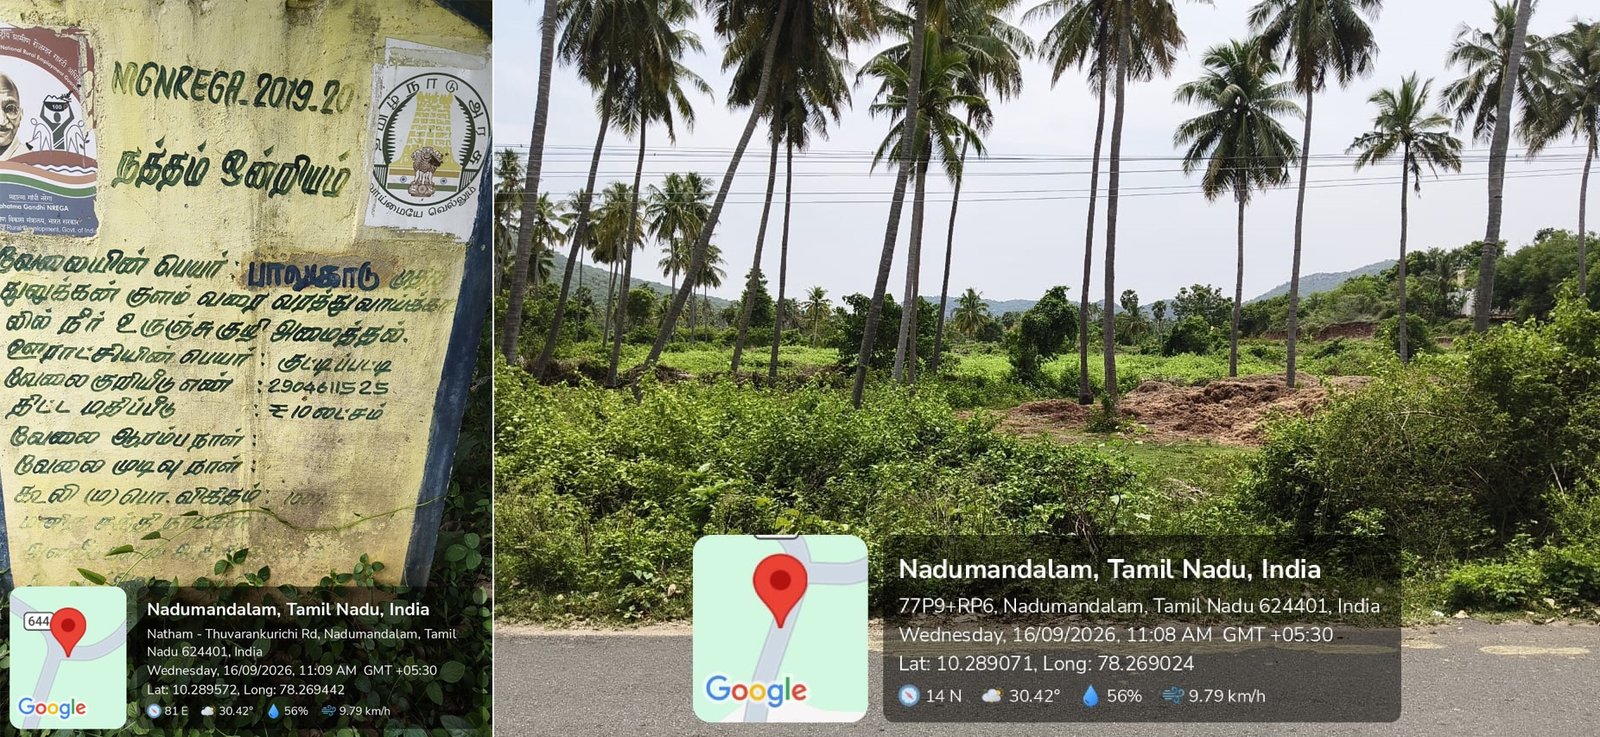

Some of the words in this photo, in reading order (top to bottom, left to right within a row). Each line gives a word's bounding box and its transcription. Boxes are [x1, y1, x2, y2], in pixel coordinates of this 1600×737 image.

[23, 49, 36, 58] Rural
[37, 55, 64, 76] Employment
[110, 134, 210, 192] நத்தம்
[221, 145, 352, 199] ஒன்றியம்
[23, 203, 46, 211] Gandhi
[46, 204, 69, 212] NREGA
[428, 185, 477, 217] வெல்லும்
[153, 250, 229, 279] பெயர்
[0, 276, 121, 307] துலுக்கன்
[126, 284, 192, 307] குளம்
[197, 291, 269, 314] வரை
[5, 308, 52, 332] லில்
[57, 307, 104, 335] நீர்
[7, 338, 177, 364] ஊராட்சியின்
[179, 347, 256, 367] பெயர்
[4, 366, 90, 389] வேலை
[91, 369, 176, 394] குறியீடு
[179, 371, 234, 393] எண்
[5, 394, 71, 420] திட்ட
[80, 396, 177, 419] மதிப்பீடு
[10, 425, 101, 447] வேலை
[13, 454, 106, 476] வேலை
[182, 455, 243, 476] நாள்
